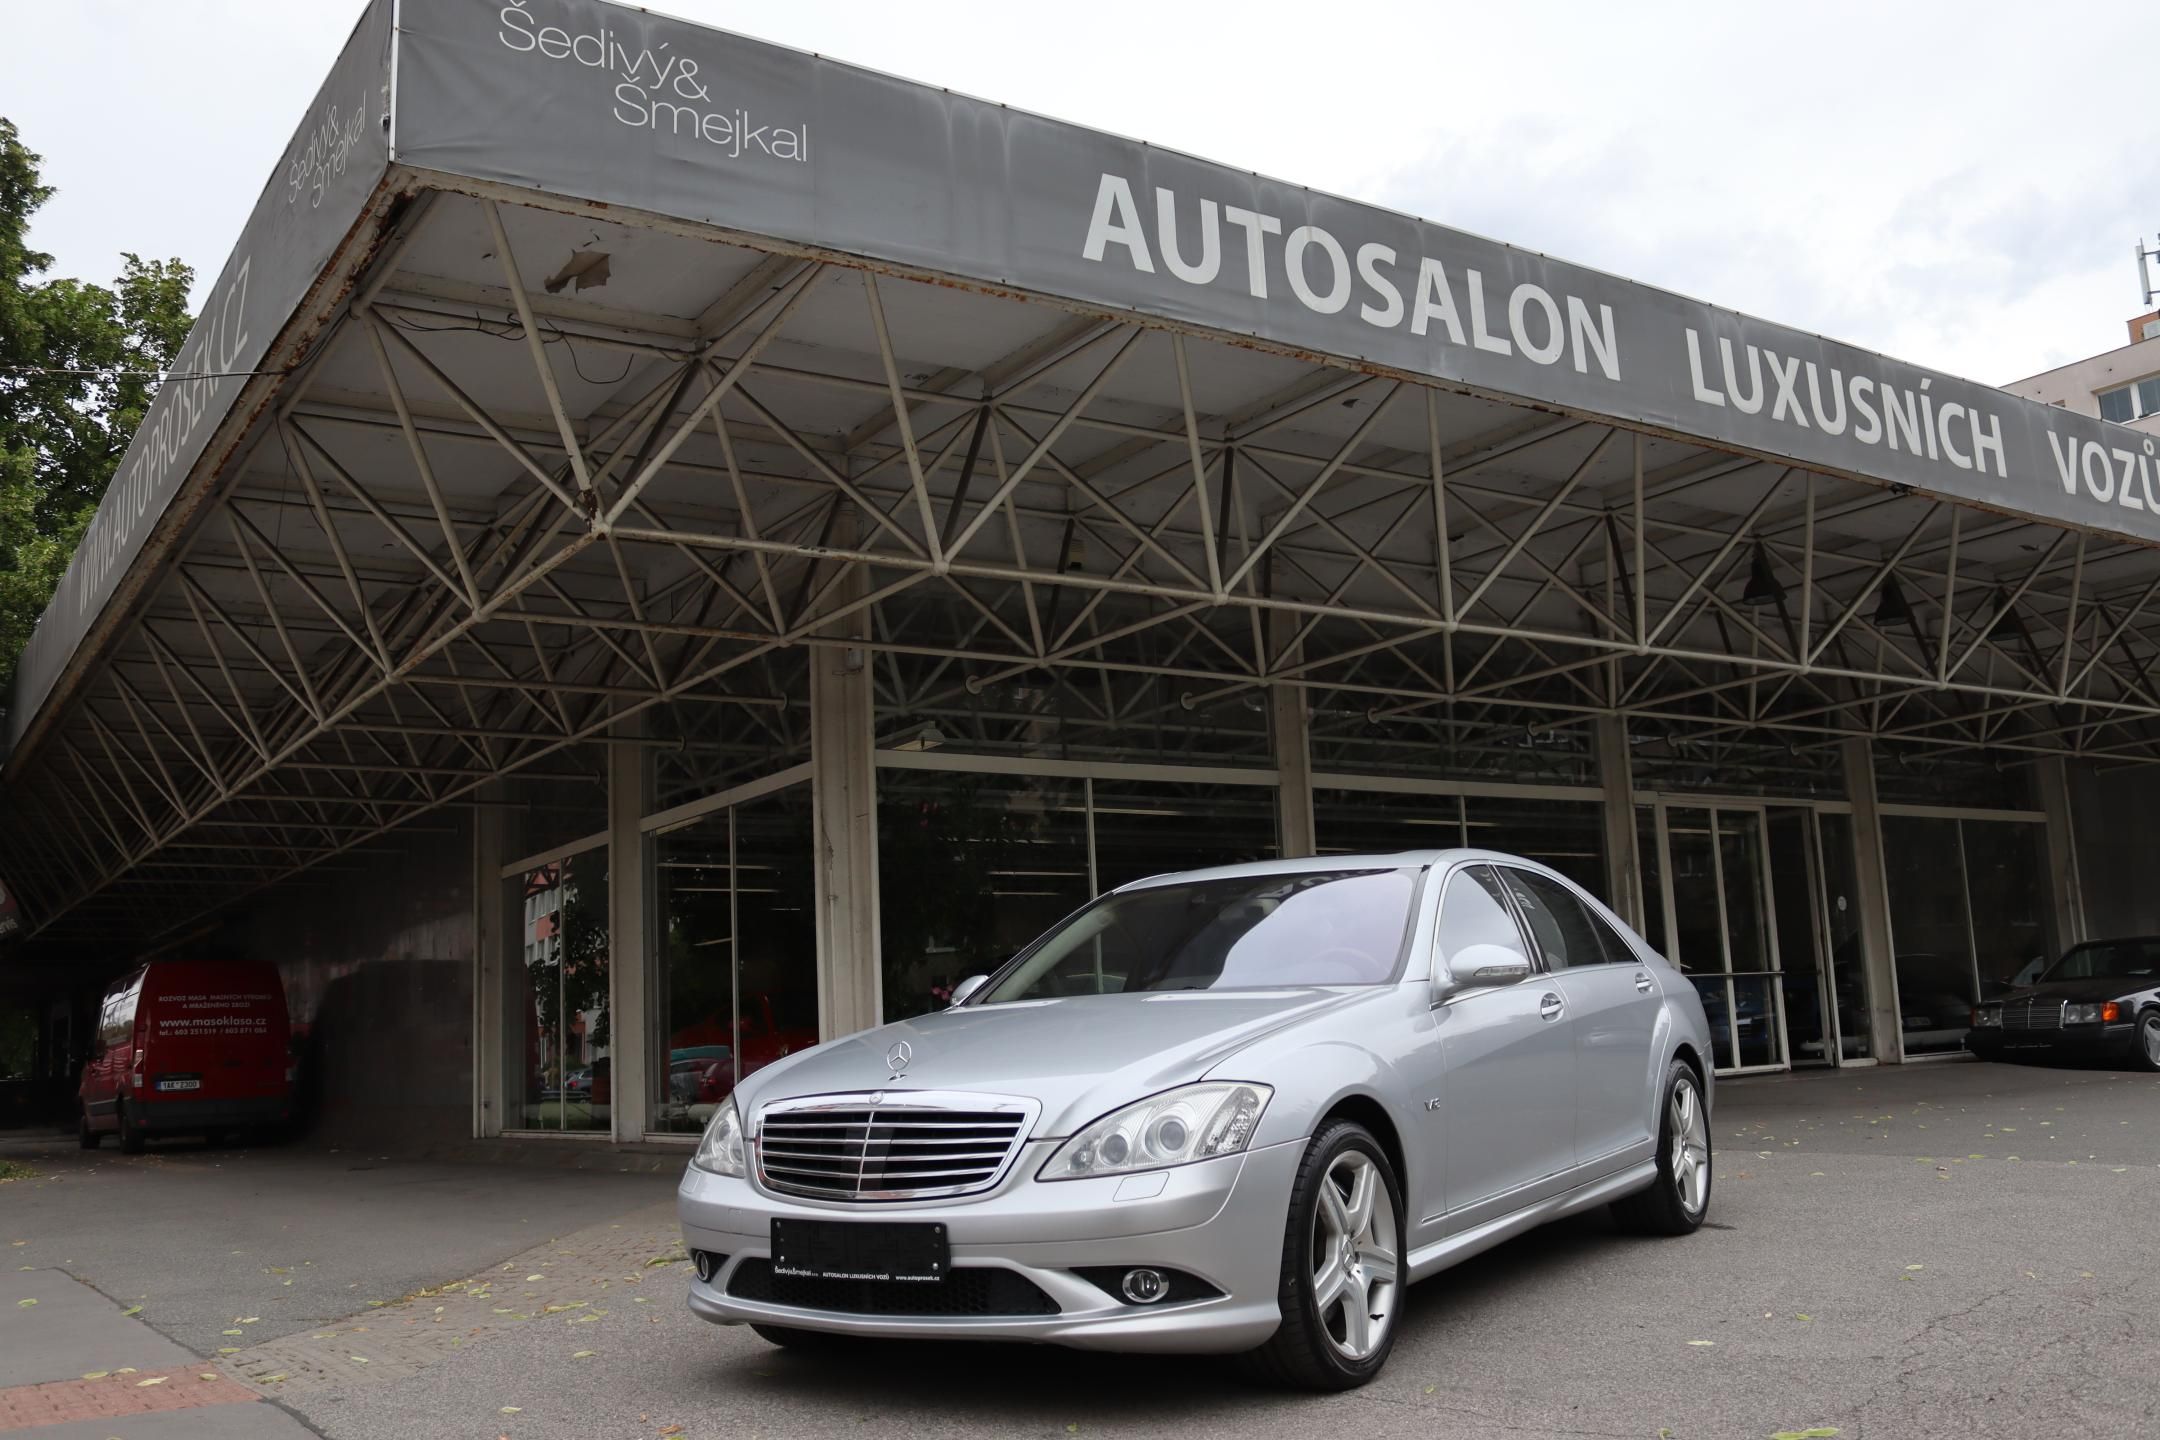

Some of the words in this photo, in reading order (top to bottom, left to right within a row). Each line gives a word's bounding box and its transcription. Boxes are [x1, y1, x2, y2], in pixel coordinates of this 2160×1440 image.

[614, 72, 807, 162] Šmejkal
[1082, 172, 1621, 382] AUTOSALON
[1685, 327, 2007, 479] LUXUSNÍCH
[159, 1015, 267, 1027] www.masoklasa.cz
